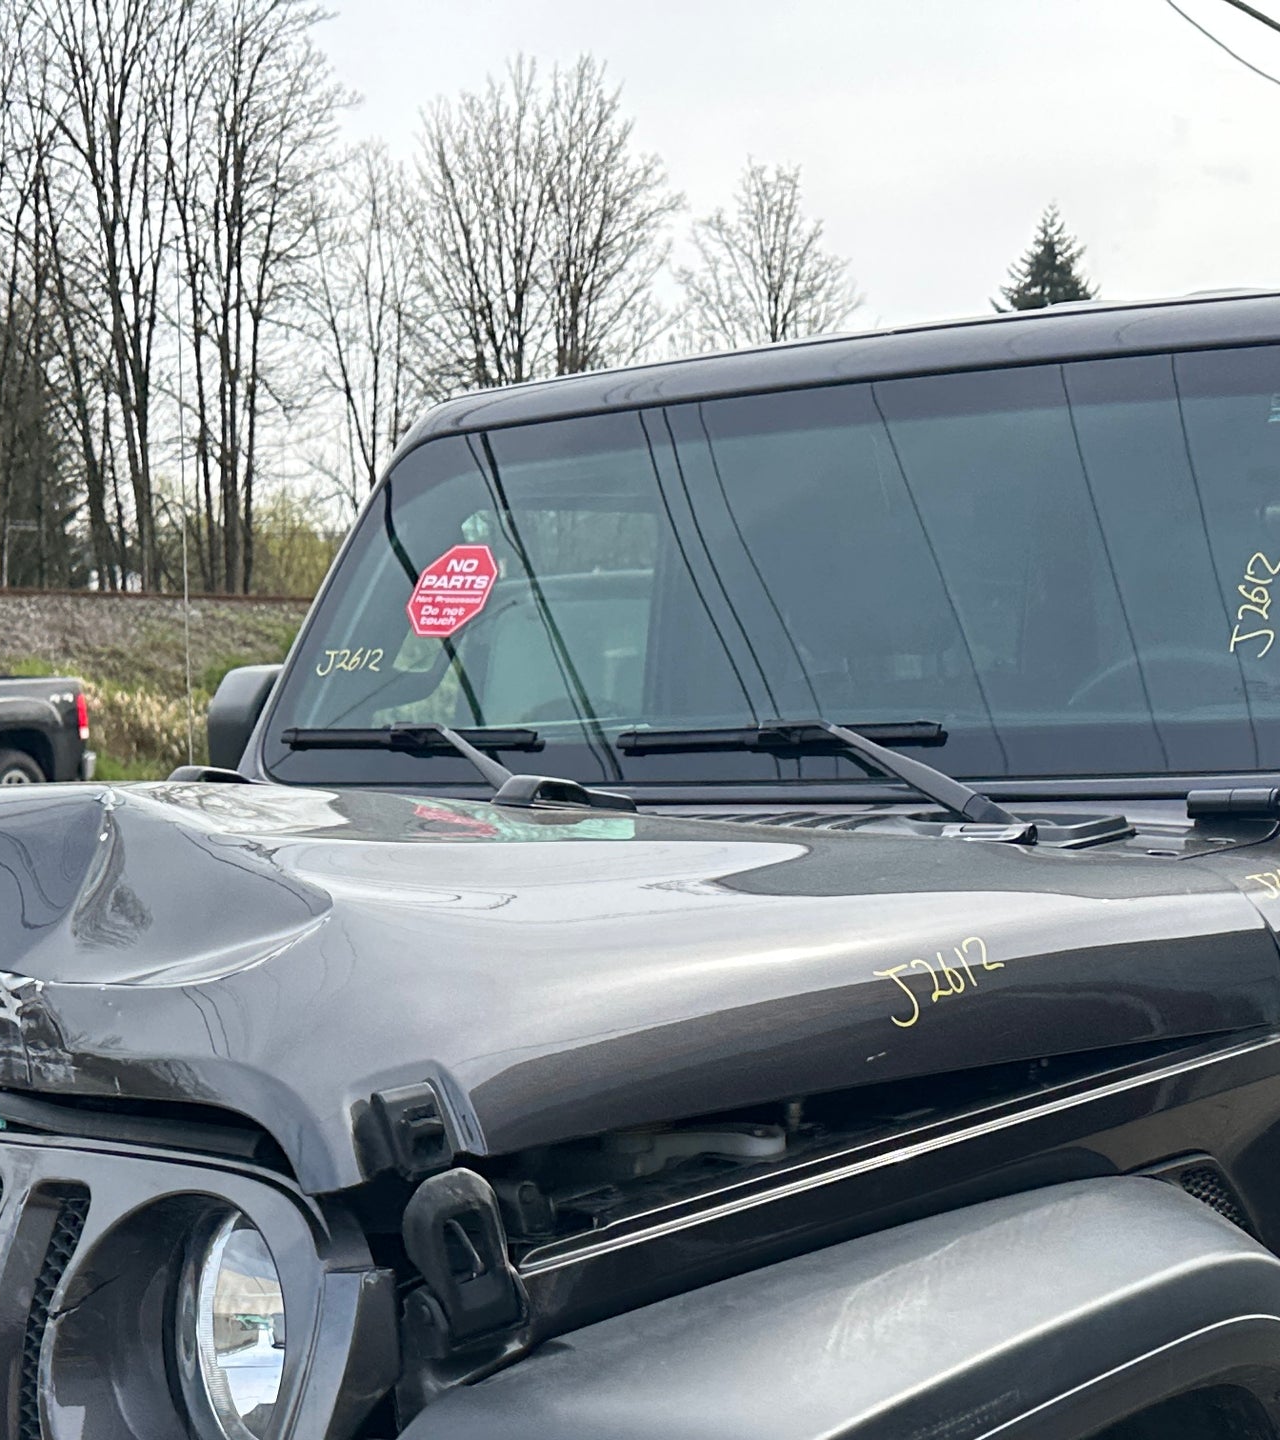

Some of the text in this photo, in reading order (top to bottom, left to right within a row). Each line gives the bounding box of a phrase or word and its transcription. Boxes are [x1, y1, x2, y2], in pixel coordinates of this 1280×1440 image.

[446, 559, 479, 573] NO
[421, 574, 490, 589] PARTS
[421, 605, 466, 616] Do not
[420, 616, 457, 626] touch
[316, 648, 384, 677] J2612
[873, 936, 1005, 1028] J2612
